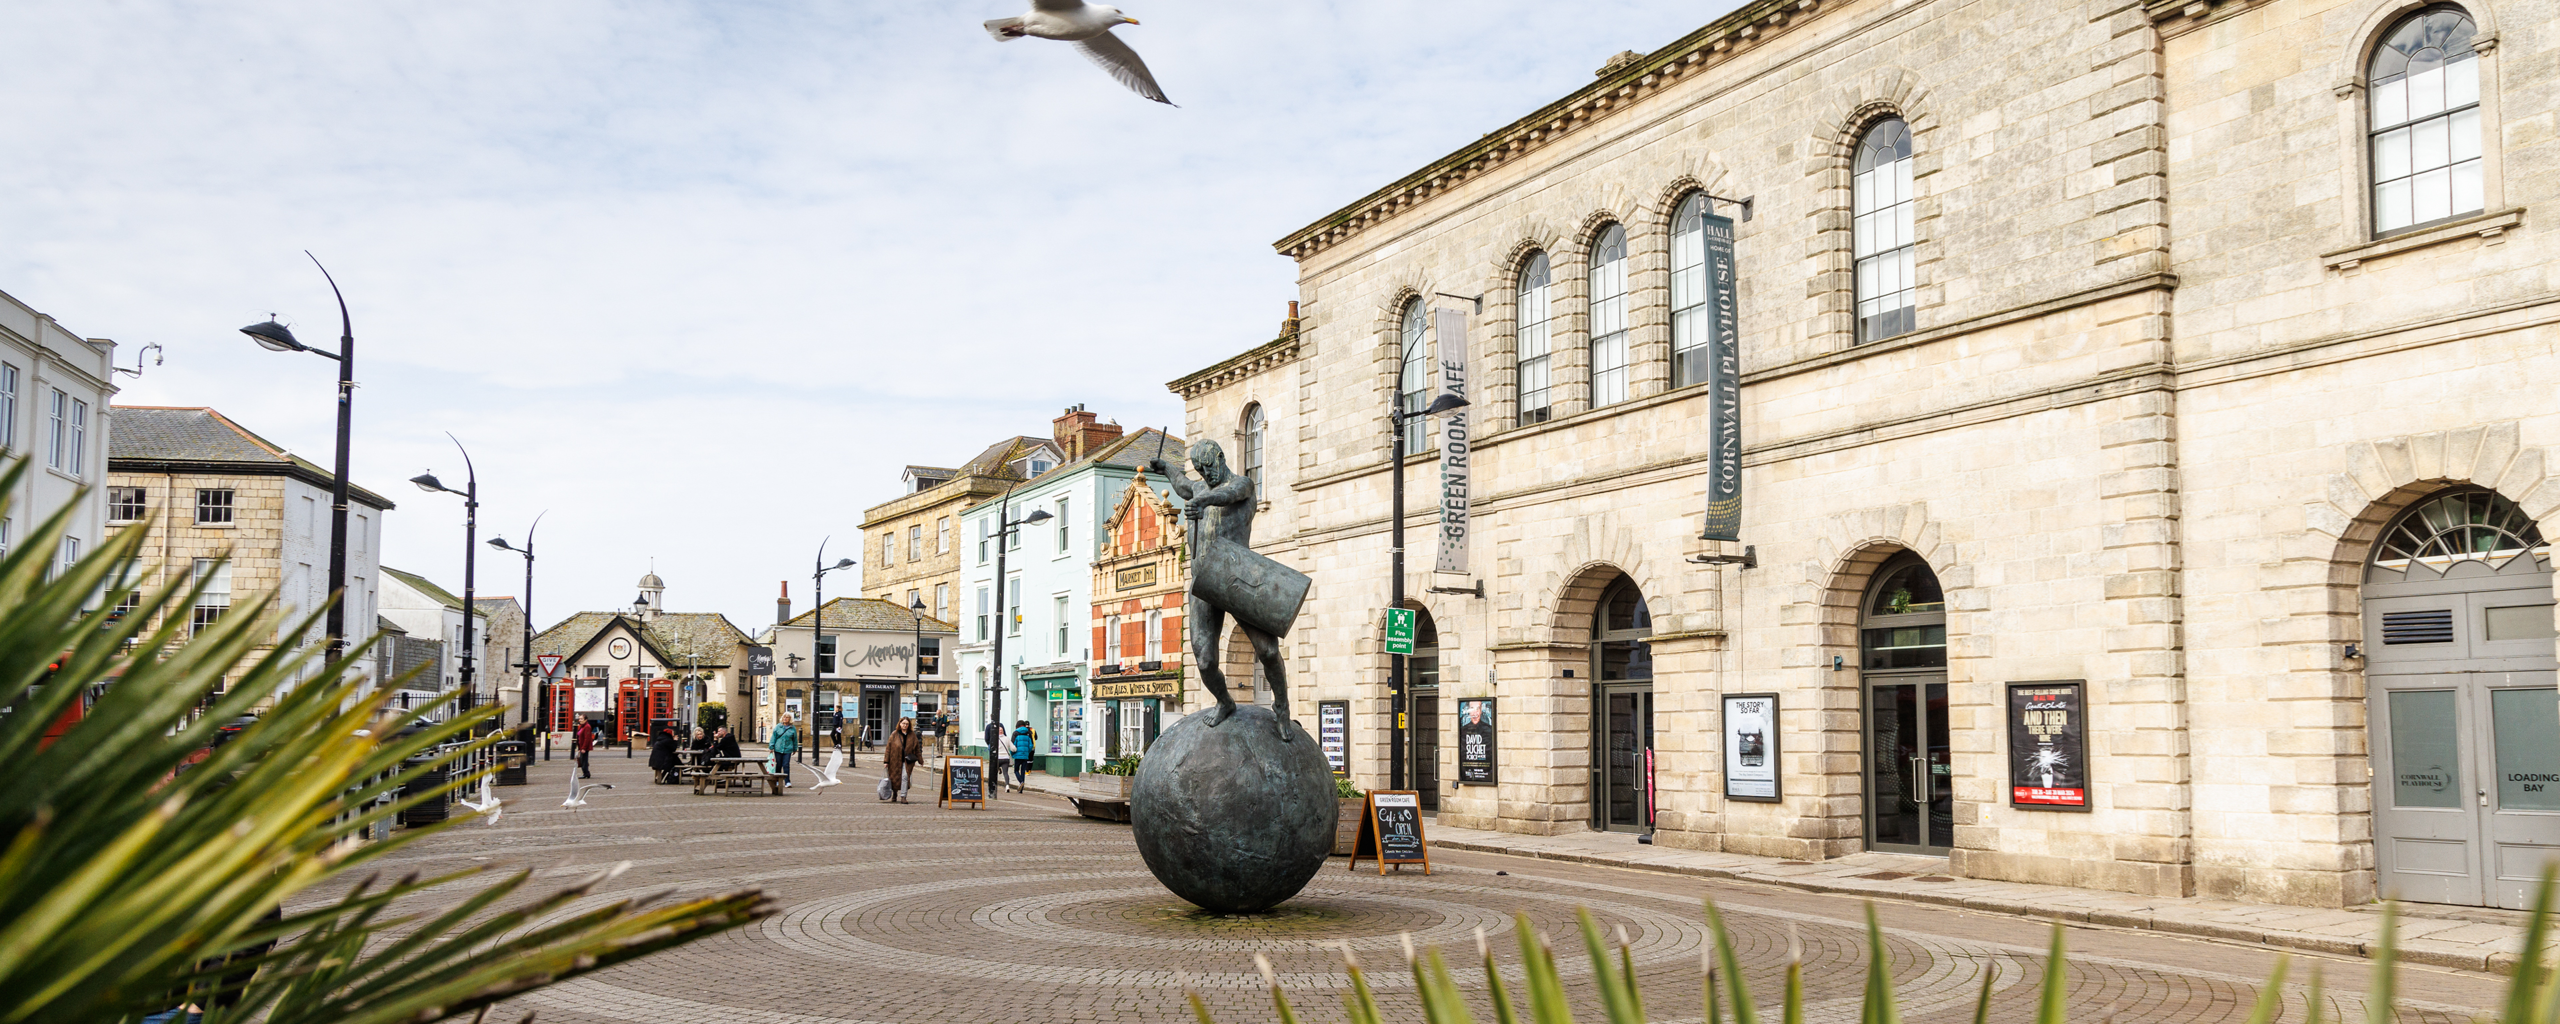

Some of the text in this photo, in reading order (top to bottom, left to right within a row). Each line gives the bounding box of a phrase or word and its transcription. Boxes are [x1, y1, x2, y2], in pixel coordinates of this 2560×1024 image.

[1707, 225, 1731, 239] HALL
[1710, 245, 1725, 253] HOME
[1716, 257, 1736, 494] CORNWALL PLAYHOUSE
[1441, 360, 1467, 537] GREEN ROOM AFÉ
[1119, 571, 1141, 587] MARKET
[1387, 636, 1412, 645] assembly
[1101, 684, 1114, 696] FINE
[1114, 684, 1129, 695] ALES,
[1129, 683, 1146, 694] WINES
[1146, 684, 1151, 692] &
[2023, 710, 2067, 725] AND THEN
[2028, 725, 2063, 734] THERE WERE
[1466, 734, 1482, 745] DAVID
[1466, 744, 1486, 755] SUCHET
[952, 766, 966, 778] This
[2508, 773, 2560, 782] LOADING
[2524, 784, 2545, 792] BAY
[1395, 822, 1412, 835] OPEN
